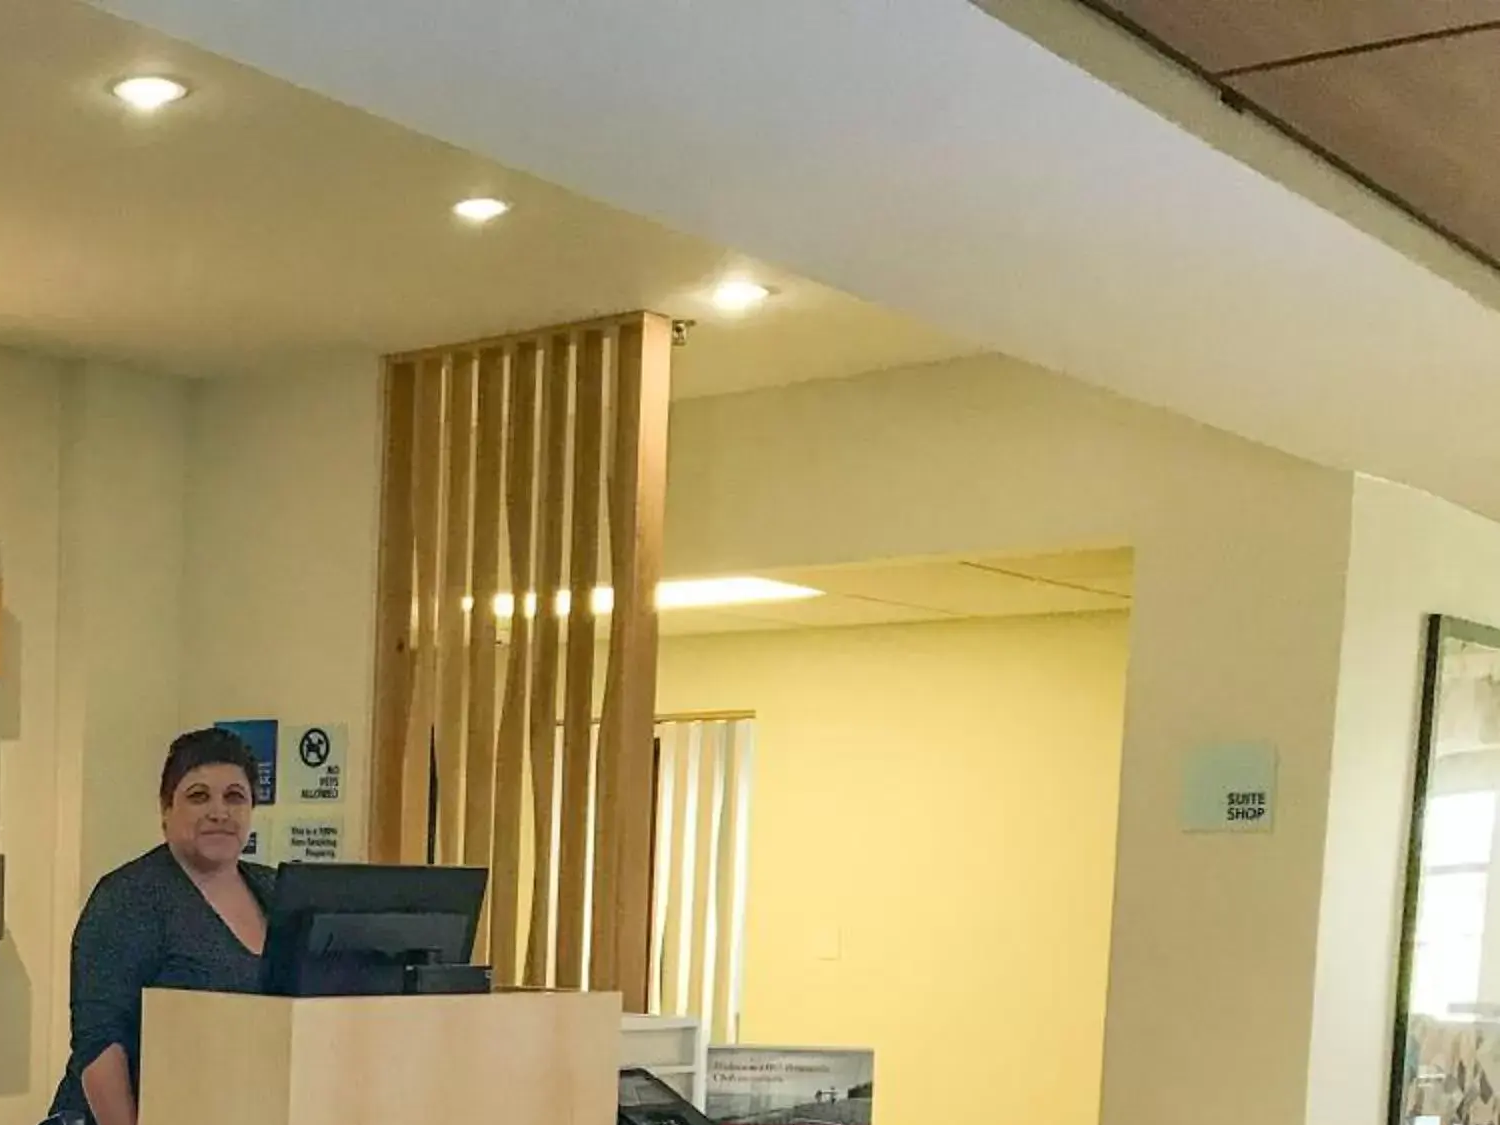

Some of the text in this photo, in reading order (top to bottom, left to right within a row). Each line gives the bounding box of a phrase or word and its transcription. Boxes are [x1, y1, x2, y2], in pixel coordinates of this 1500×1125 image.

[327, 765, 340, 774] NO
[319, 777, 339, 786] PETS
[301, 789, 339, 799] ALLOWED
[1227, 792, 1266, 805] SUITE
[1227, 808, 1265, 820] SHOP
